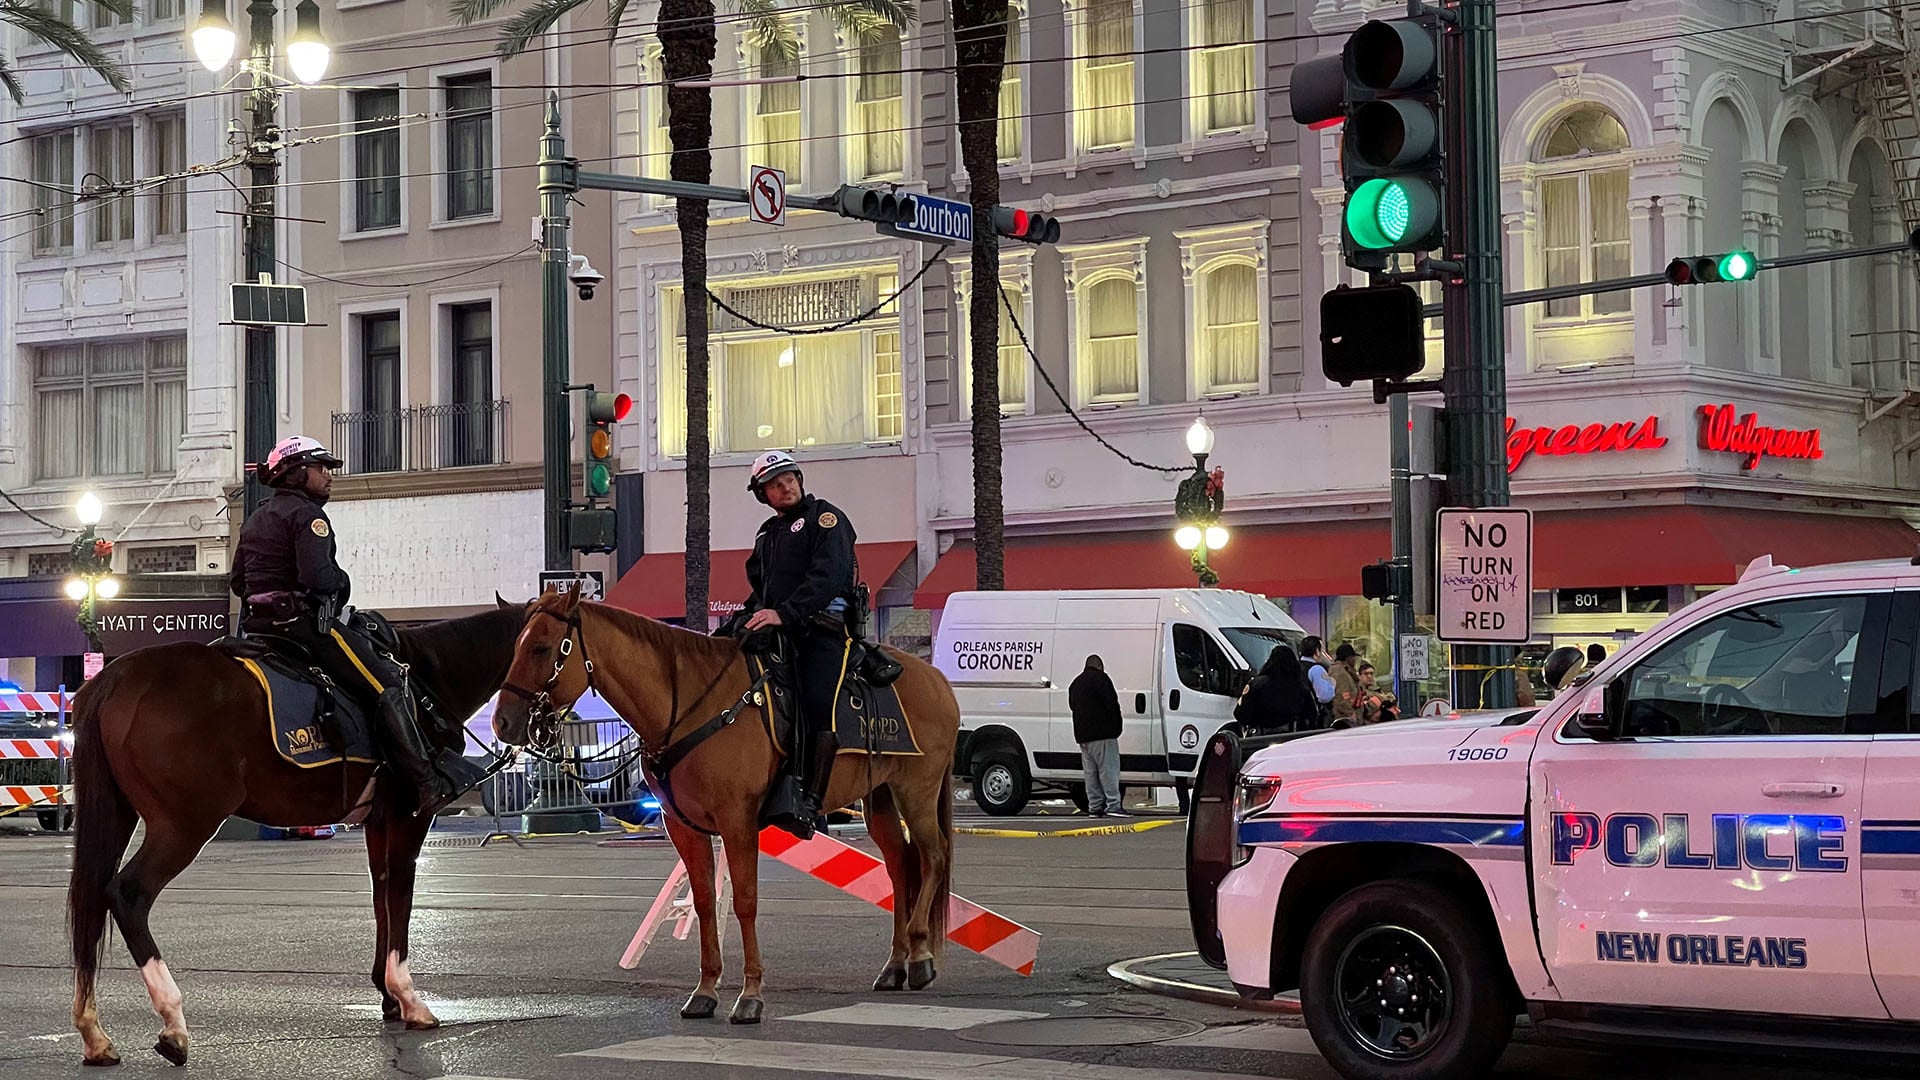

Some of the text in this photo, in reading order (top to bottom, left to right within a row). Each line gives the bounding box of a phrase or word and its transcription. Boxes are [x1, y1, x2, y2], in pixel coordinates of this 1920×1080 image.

[1696, 403, 1824, 471] Walgreens
[1465, 523, 1507, 548] NO
[1458, 557, 1513, 575] TURN
[1471, 584, 1499, 602] ON
[1575, 594, 1599, 607] 801
[97, 614, 225, 634] HYATT CENTRIC
[1465, 611, 1505, 630] RED
[953, 641, 1043, 653] ORLEANS PARISH
[1407, 637, 1422, 648] NO
[957, 653, 1034, 670] CORONER
[284, 725, 323, 747] NOP
[1447, 747, 1509, 761] 19060
[1550, 812, 1849, 872] POLICE
[1596, 931, 1808, 969] NEW ORLEANS
